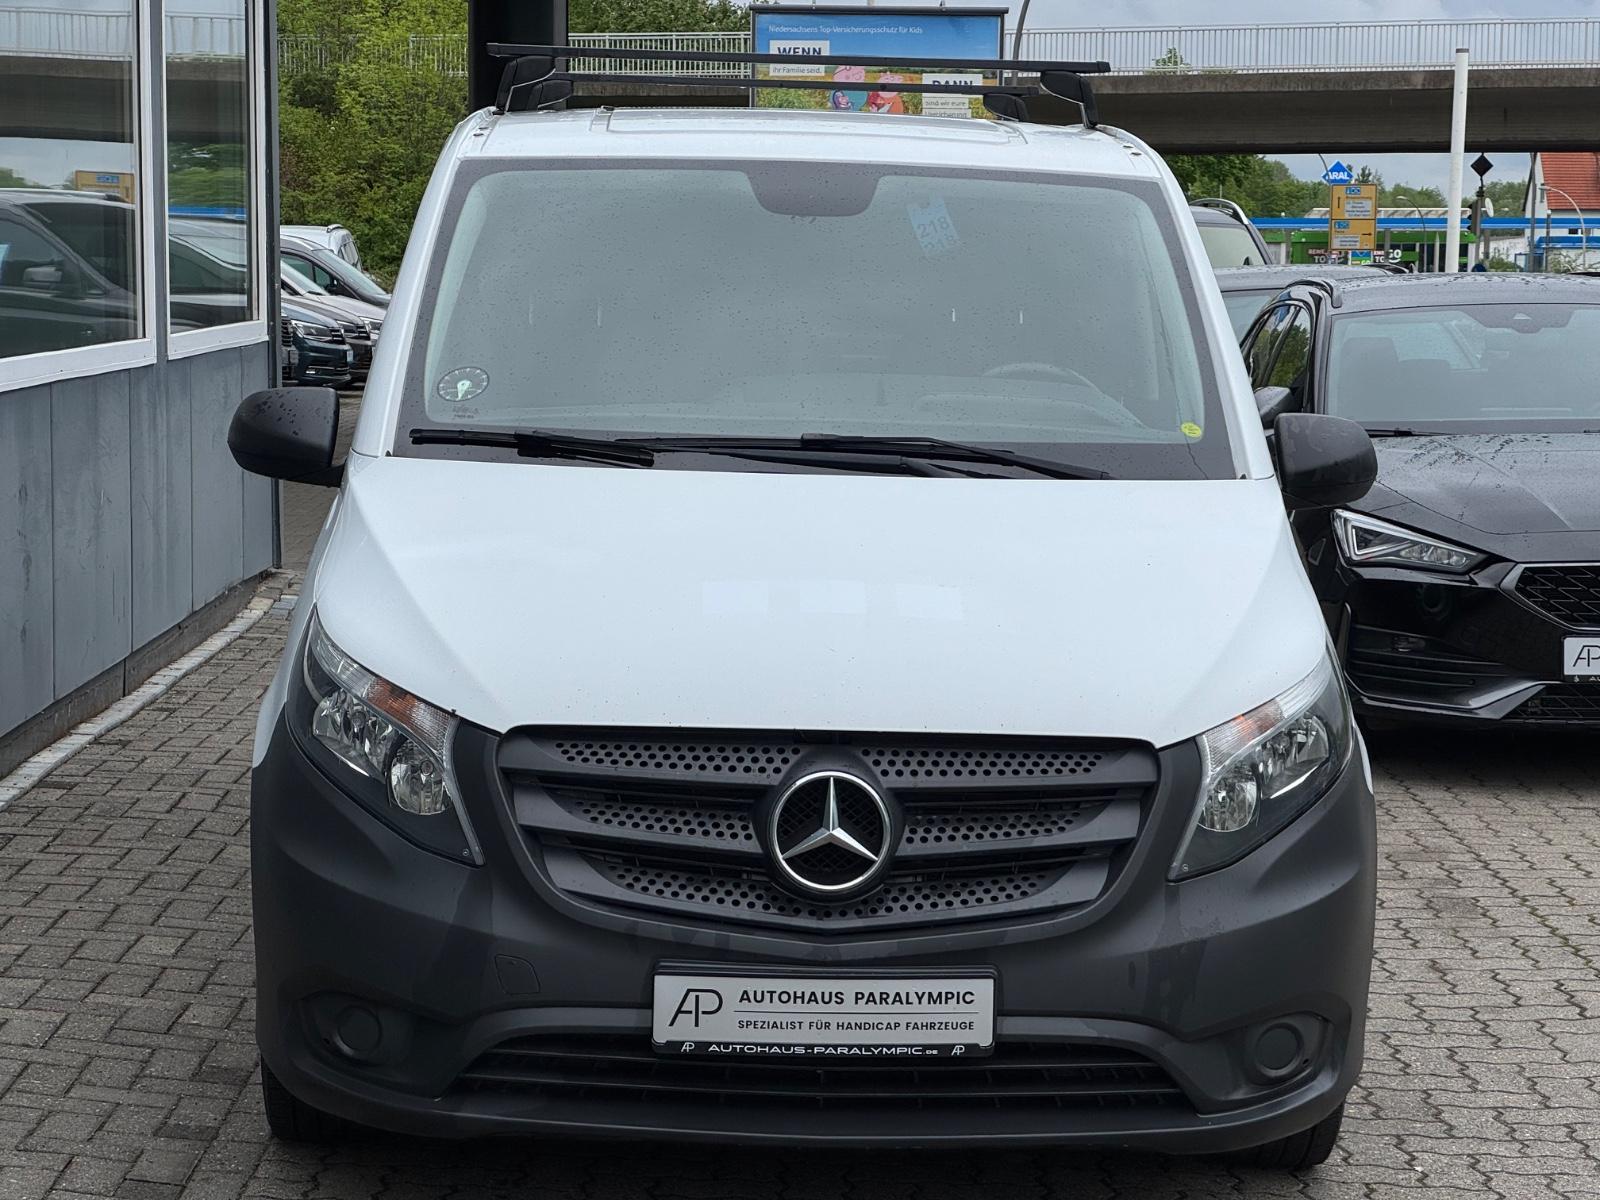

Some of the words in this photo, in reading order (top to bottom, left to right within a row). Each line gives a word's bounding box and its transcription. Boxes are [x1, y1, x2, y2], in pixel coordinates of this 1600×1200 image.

[777, 46, 822, 56] WENN
[1325, 171, 1350, 180] ARAL
[738, 989, 845, 1006] AUTOHAUS
[854, 990, 976, 1006] PARALYMPIC
[737, 1020, 805, 1031] SPEZIALIST
[808, 1018, 832, 1031] FÜR
[836, 1021, 902, 1032] HANDICAP
[905, 1021, 975, 1032] FAHRZEUGE
